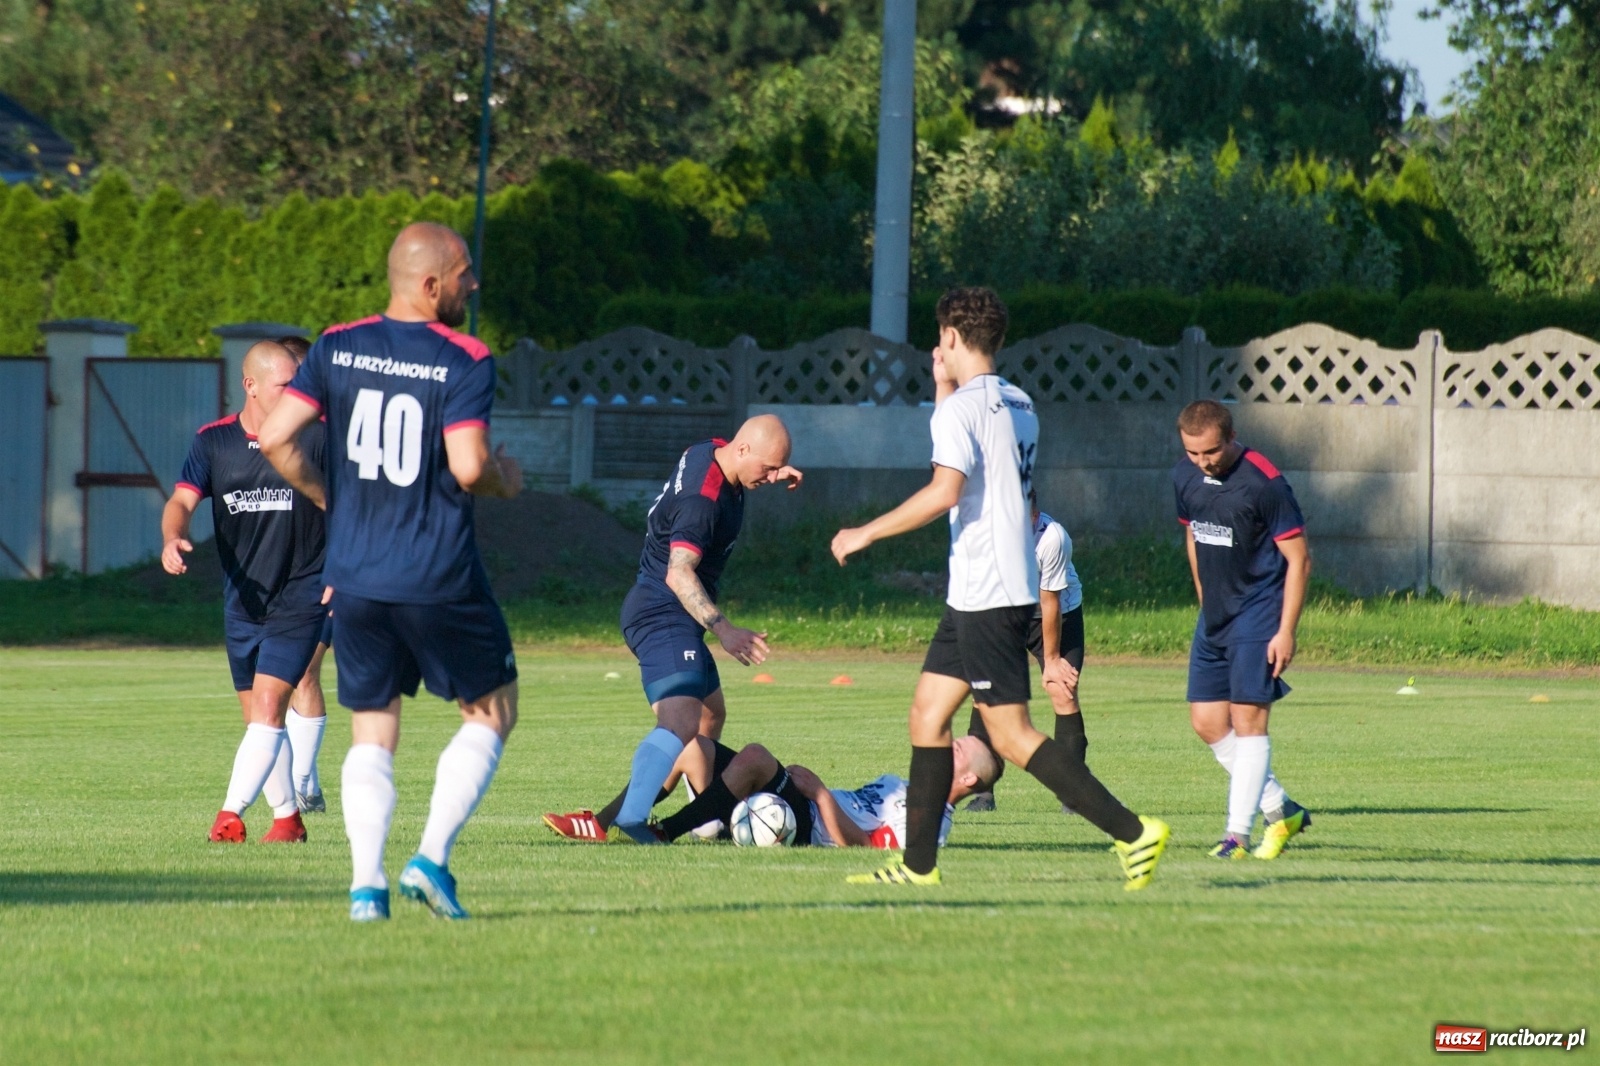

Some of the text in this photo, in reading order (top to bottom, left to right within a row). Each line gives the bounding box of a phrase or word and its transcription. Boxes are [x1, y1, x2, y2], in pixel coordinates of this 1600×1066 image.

[332, 350, 448, 382] LKS KRZYŻANOWCE
[347, 388, 423, 487] 40
[244, 487, 293, 502] KÜHN
